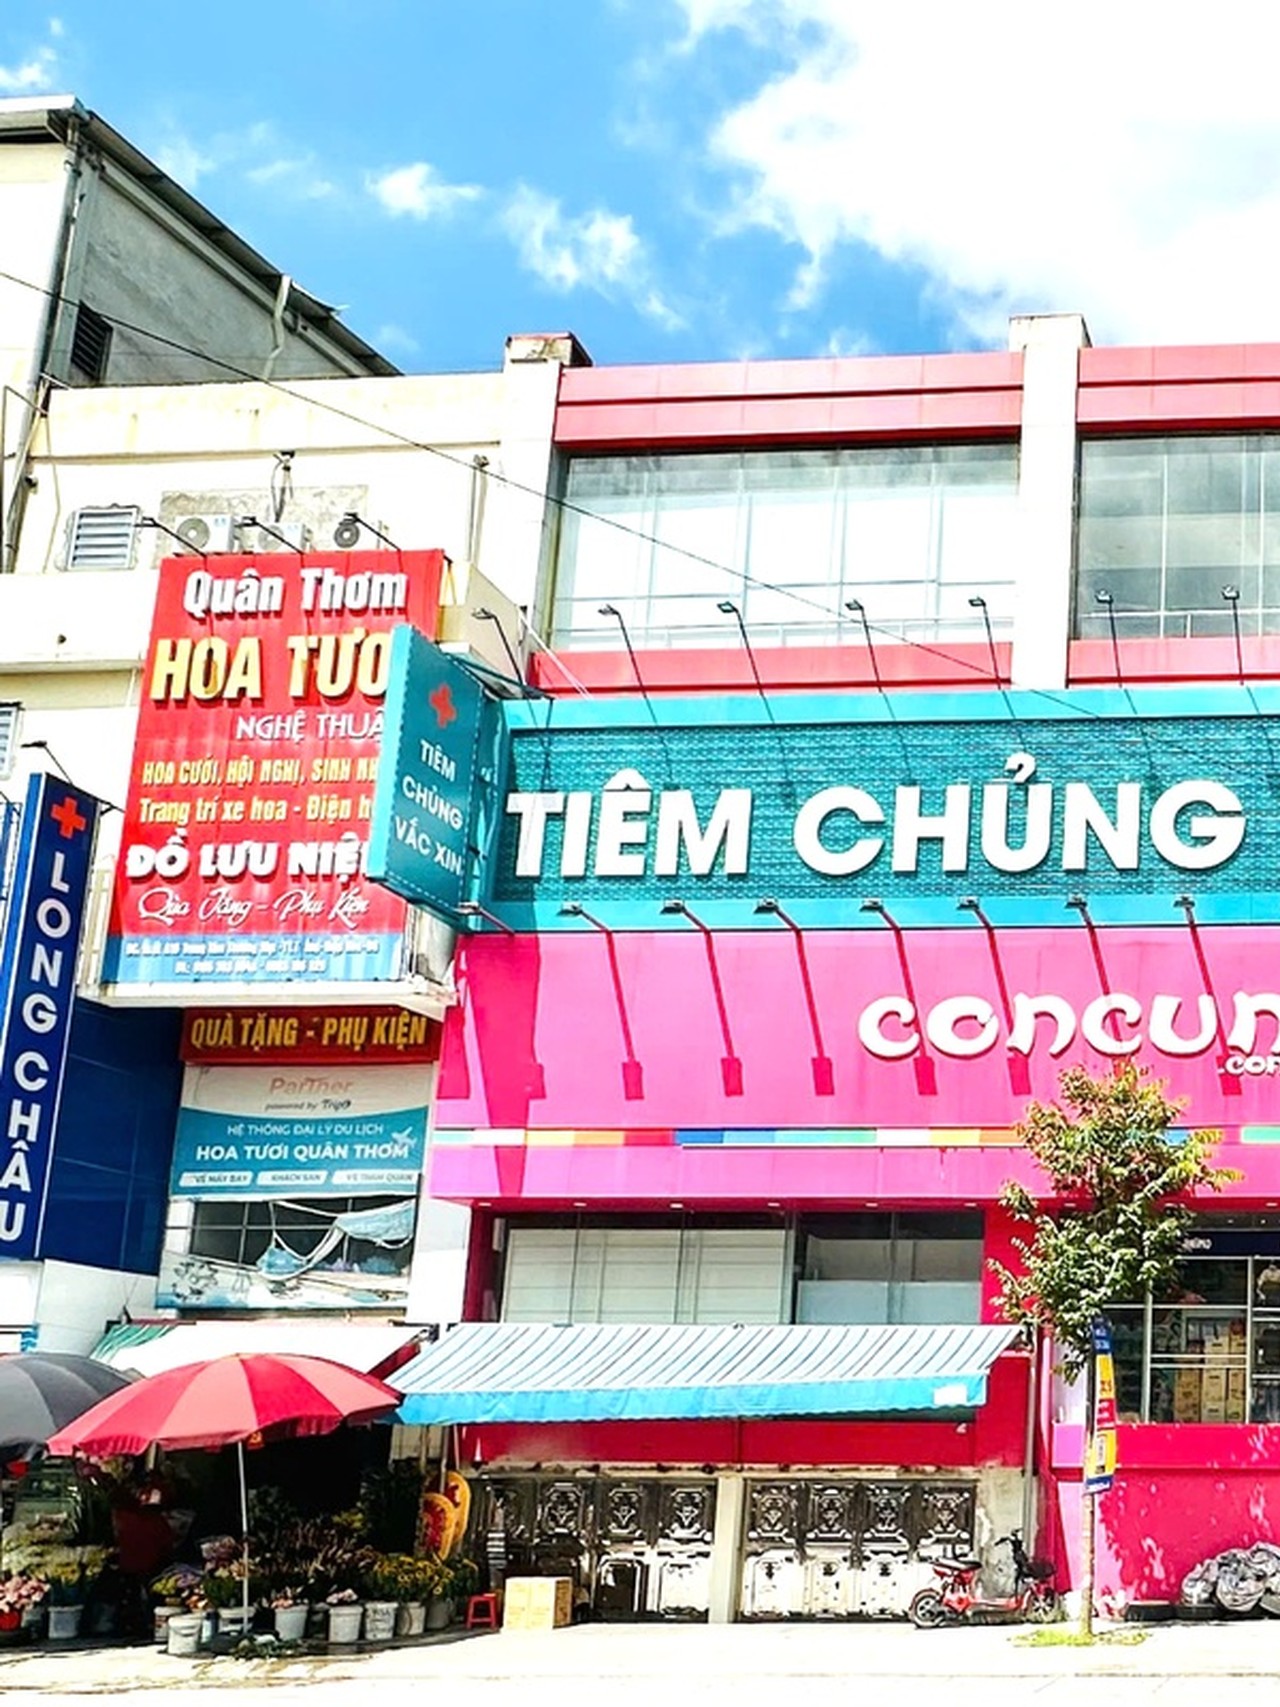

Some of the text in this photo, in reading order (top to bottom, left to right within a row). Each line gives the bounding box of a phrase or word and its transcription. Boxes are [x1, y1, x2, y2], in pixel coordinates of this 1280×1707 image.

[183, 567, 407, 618] Quân Thơm
[150, 636, 263, 700] HOA
[237, 709, 305, 741] NGHỆ
[142, 761, 175, 785] HOA
[226, 755, 255, 788] HỘI
[311, 758, 352, 783] SINH
[420, 739, 456, 782] TIÊM
[140, 798, 191, 825] Trang
[196, 795, 220, 820] trí
[222, 805, 244, 821] xe
[250, 796, 287, 820] hoa
[306, 795, 352, 825] Điện
[402, 775, 464, 831] CHỦNG
[506, 768, 752, 878] TIÊM
[794, 752, 1248, 877] CHỦNG
[126, 828, 189, 877] ĐỒ
[200, 840, 278, 877] LƯU
[395, 815, 462, 877] VẮC XIN
[0, 852, 71, 1241] LONG CHÂU
[191, 1013, 234, 1047] QUÀ
[241, 1013, 299, 1051] TẶNG
[322, 1017, 369, 1051] PHỤ
[372, 1011, 427, 1050] KIỆN
[196, 1141, 409, 1162] HOA TƯƠI QUÂN THƠM
